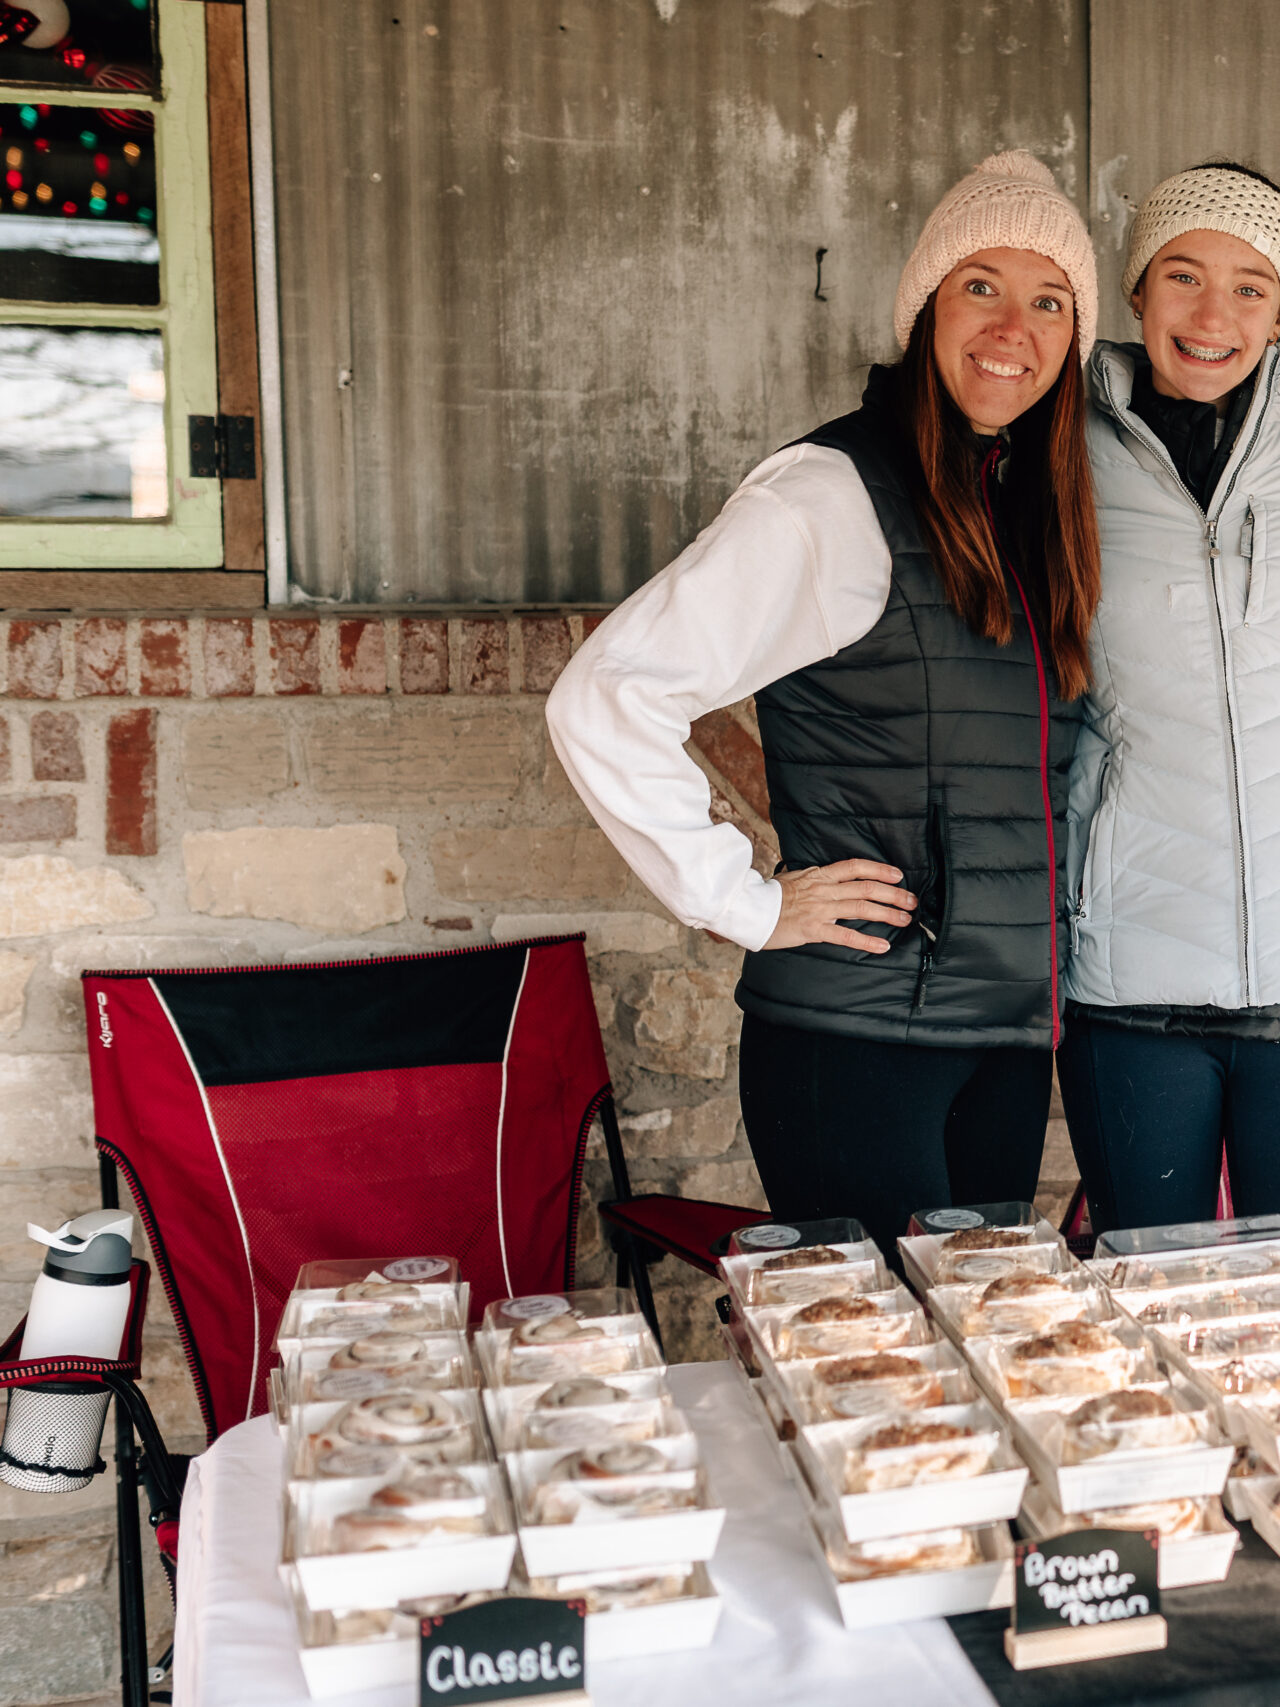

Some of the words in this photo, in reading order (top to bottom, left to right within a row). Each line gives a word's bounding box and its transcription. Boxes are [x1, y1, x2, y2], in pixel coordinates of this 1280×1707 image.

[1024, 1549, 1119, 1586] Brown
[1038, 1573, 1136, 1609] Butter
[1060, 1594, 1149, 1627] Pecan
[426, 1641, 582, 1693] Classic
